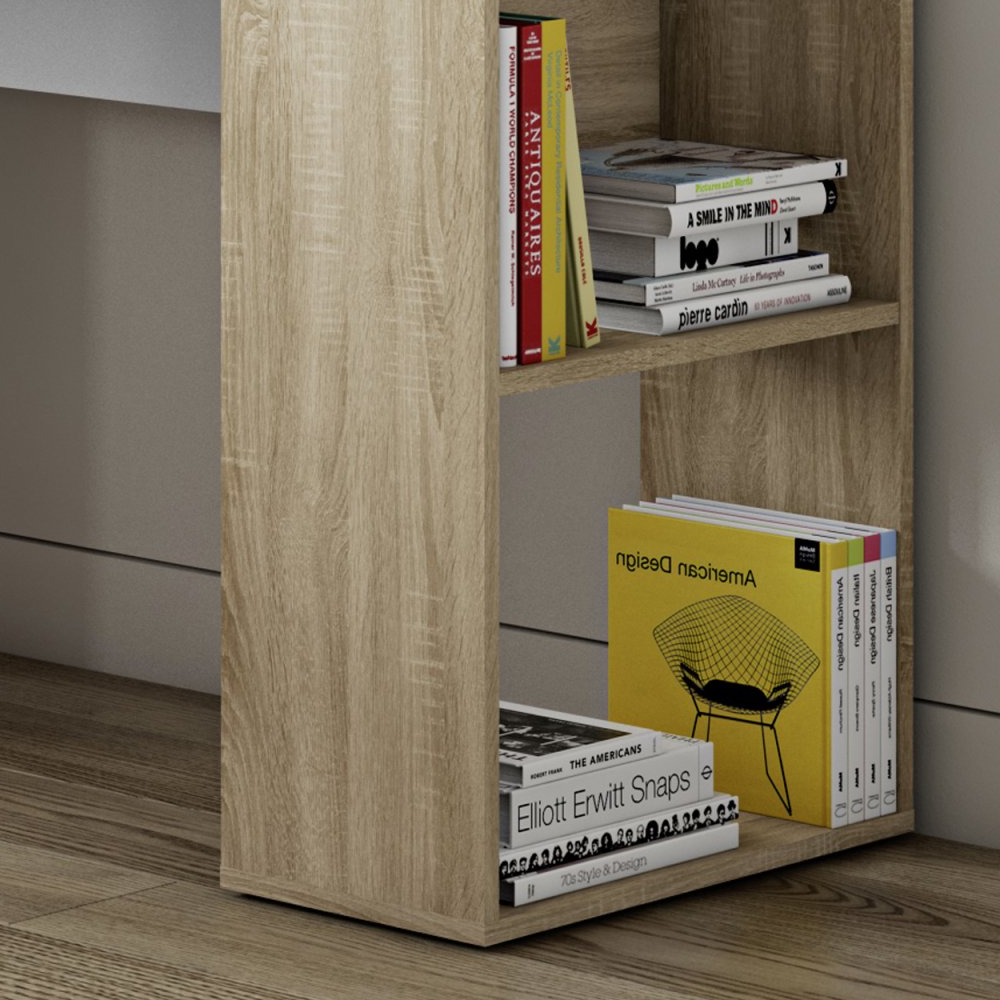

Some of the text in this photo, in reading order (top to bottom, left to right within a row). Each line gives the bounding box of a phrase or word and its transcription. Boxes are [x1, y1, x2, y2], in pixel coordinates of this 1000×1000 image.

[528, 110, 541, 277] ANTIQUAIRES
[687, 212, 694, 229] A
[696, 207, 722, 226] SMILE
[725, 205, 734, 222] IN
[736, 203, 752, 220] THE
[754, 199, 778, 218] MIND
[680, 236, 719, 272] logo
[692, 281, 707, 293] Linda
[756, 268, 785, 283] Photographs
[679, 299, 748, 331] pierre cardin
[569, 757, 587, 770] THE
[590, 743, 642, 766] AMERICANS
[530, 767, 563, 780] ROBERT FRANK
[517, 770, 691, 833] Elliott Erwitt Snaps
[561, 855, 648, 888] 70s Style & Design
